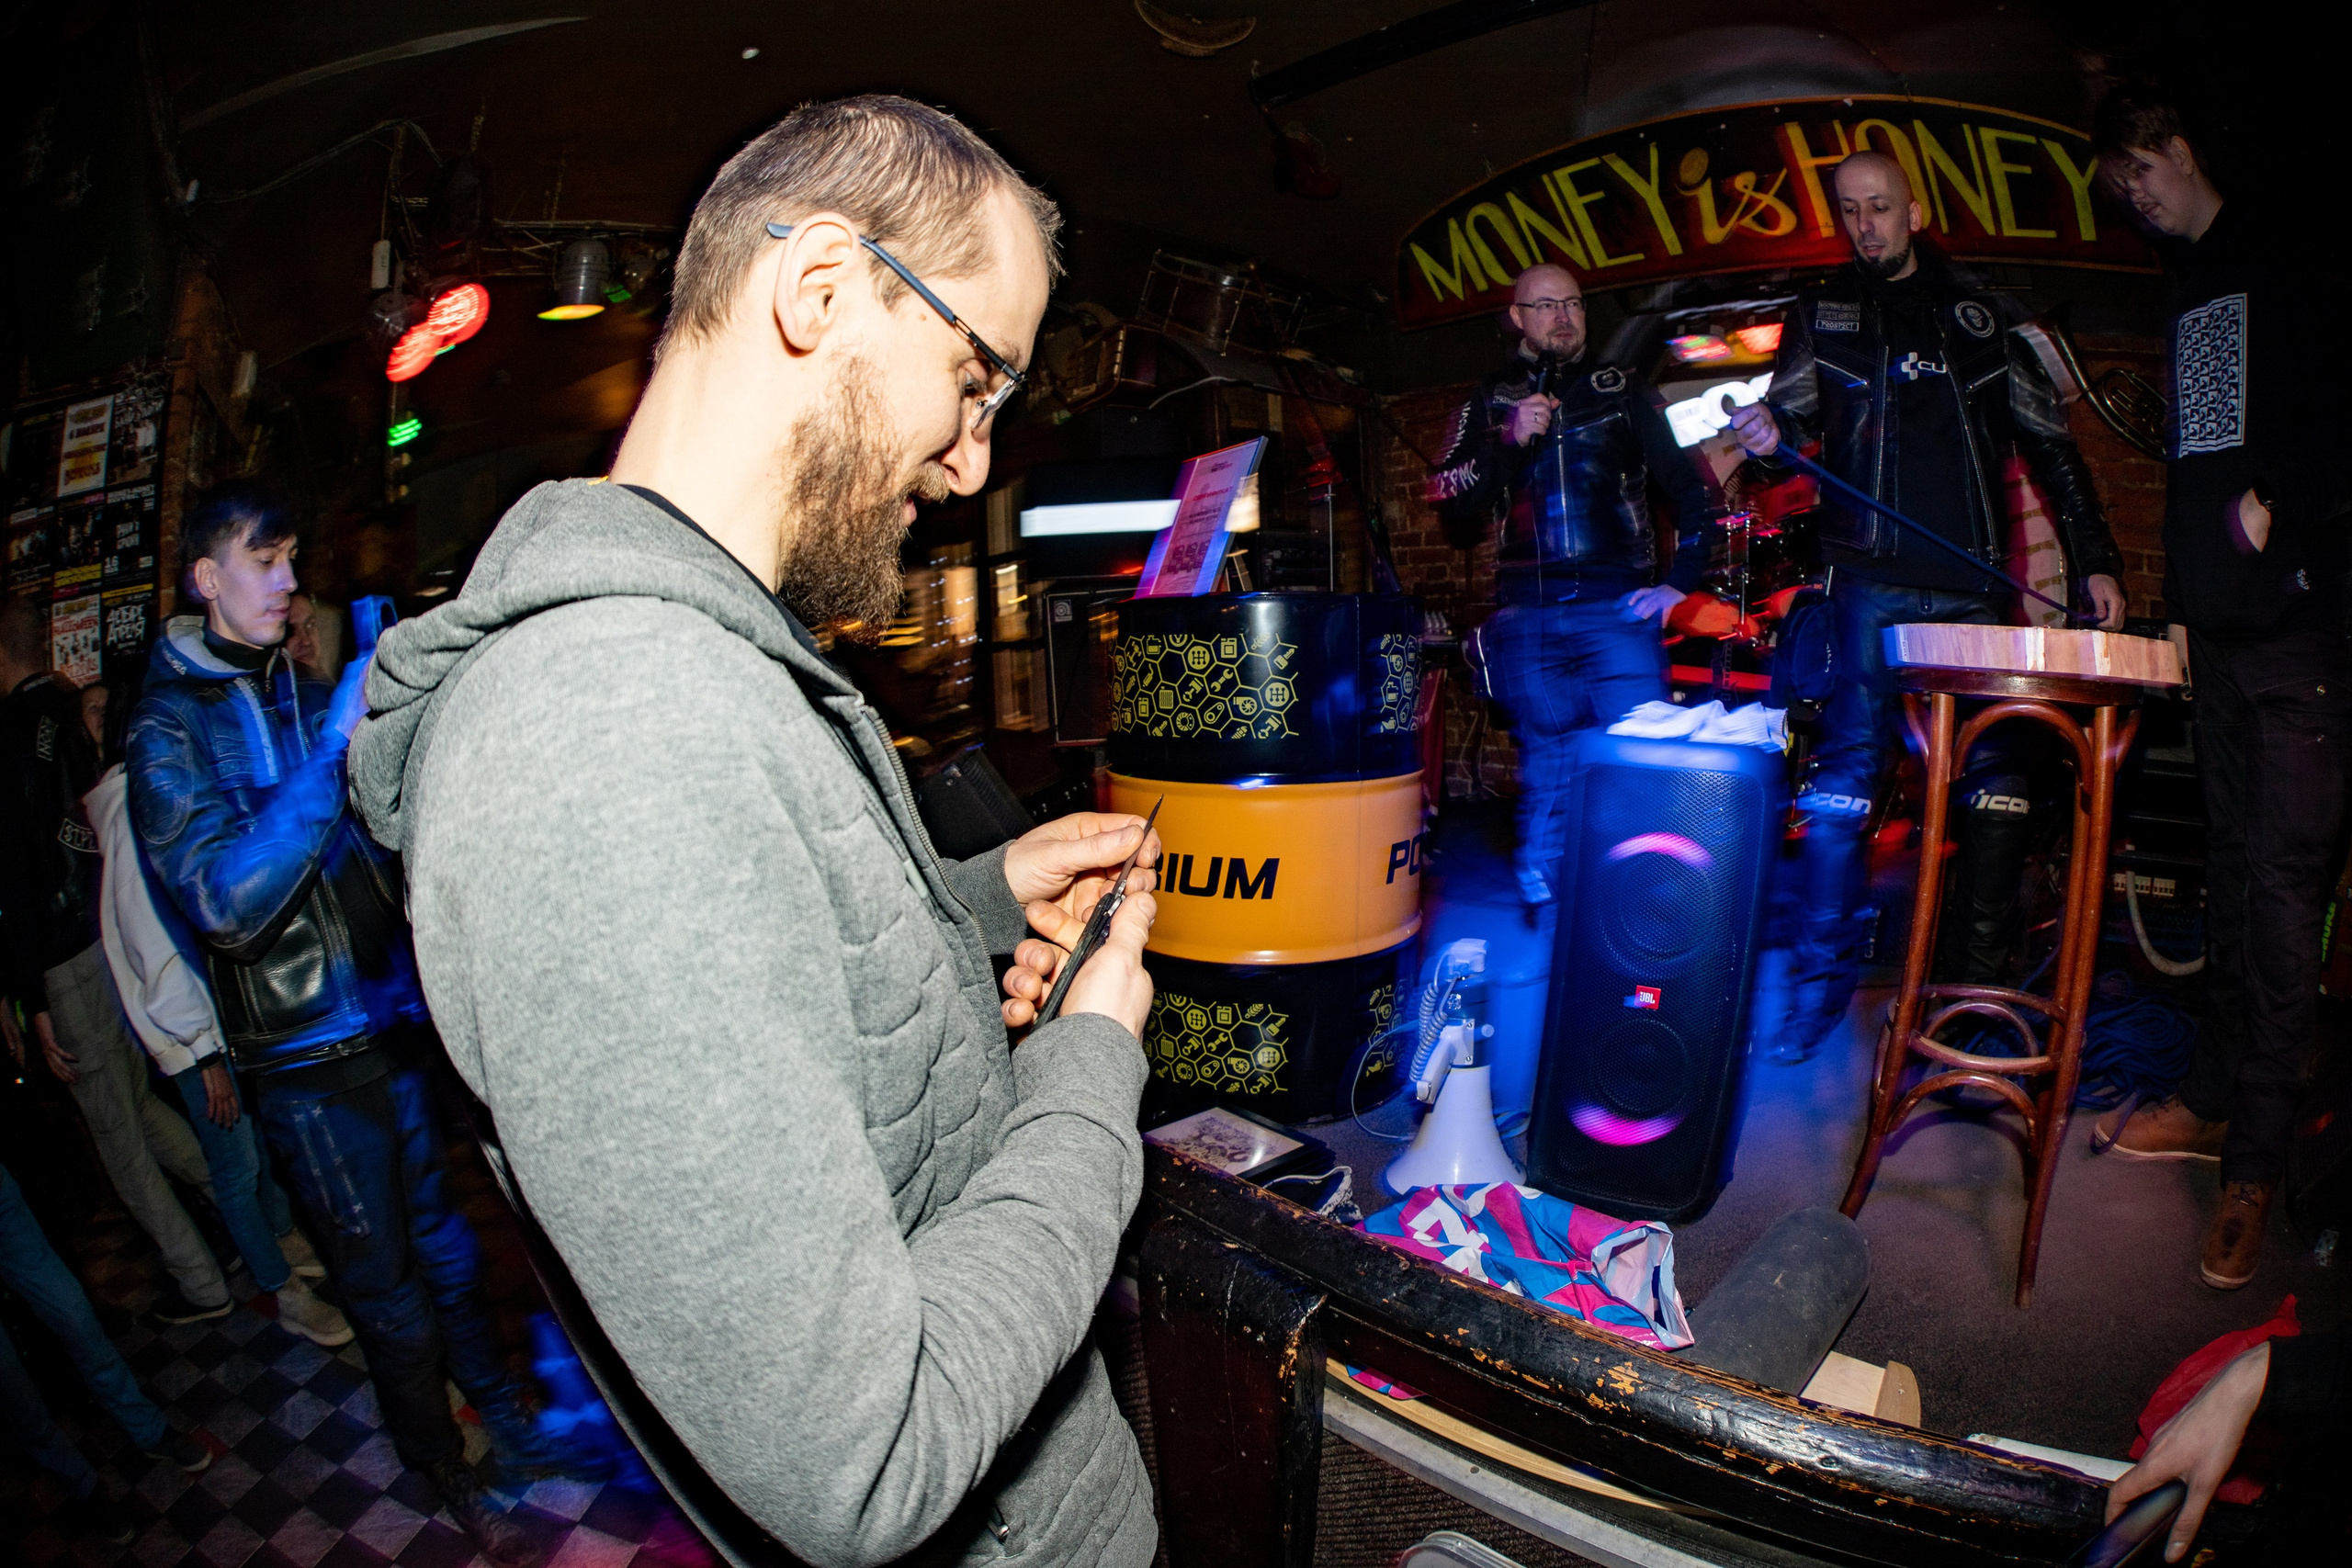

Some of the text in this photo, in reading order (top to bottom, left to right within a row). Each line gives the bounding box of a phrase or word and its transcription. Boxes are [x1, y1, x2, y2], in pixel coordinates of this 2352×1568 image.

[1410, 118, 2099, 303] MONEY is HONEY
[1820, 321, 1854, 330] PROSPECT
[1639, 991, 1657, 1004] JBL
